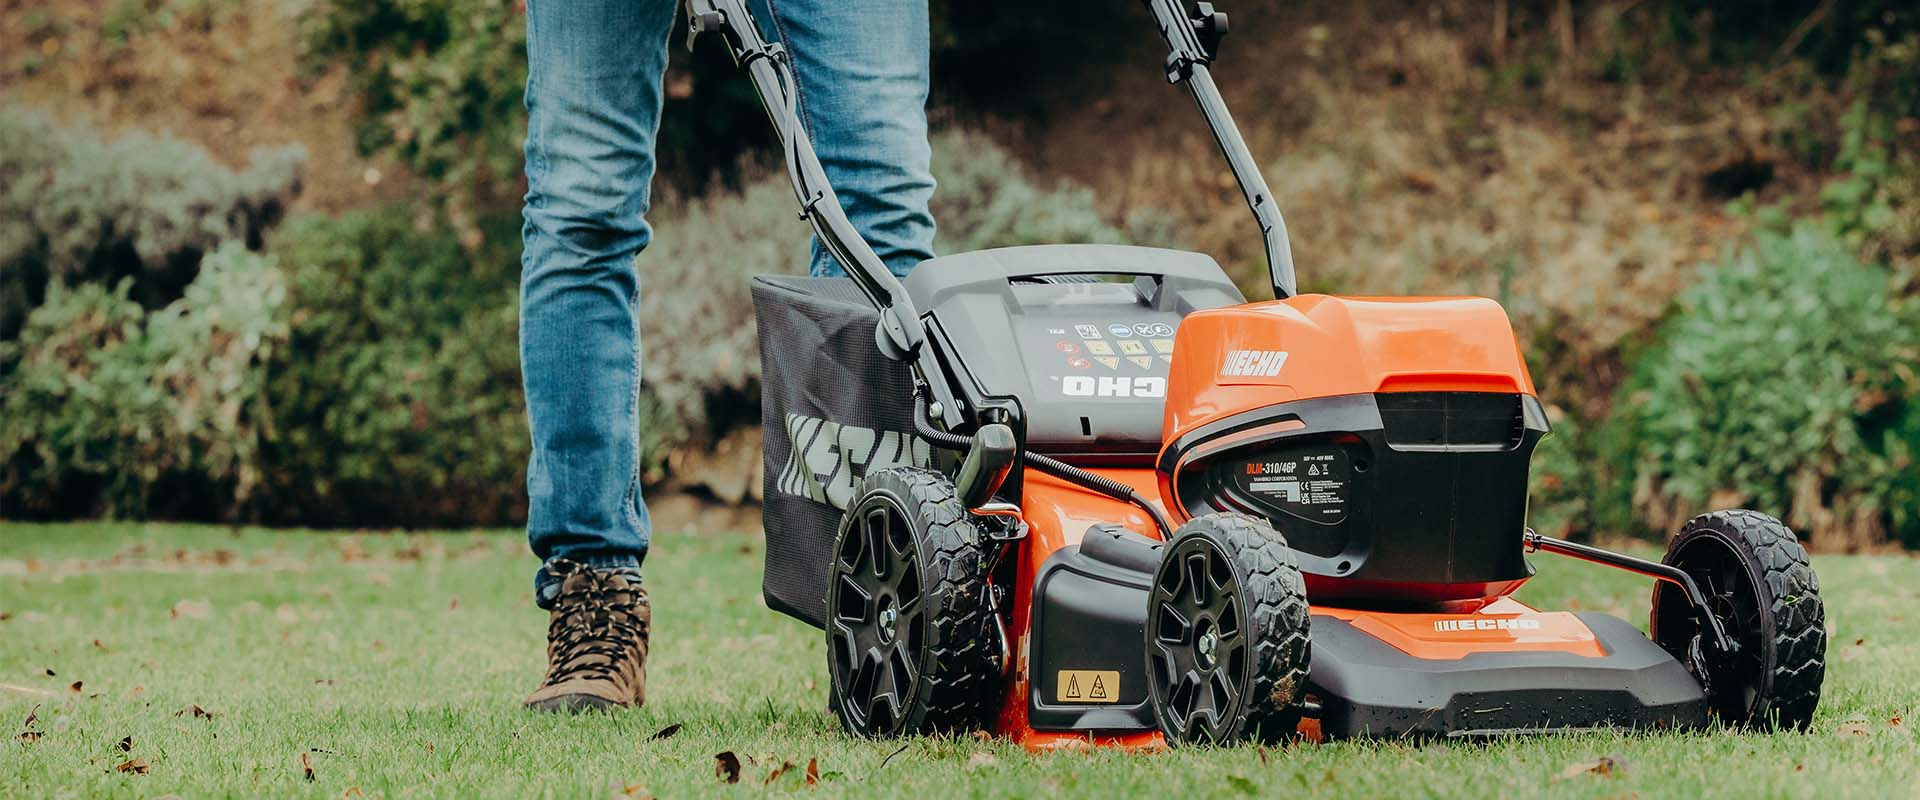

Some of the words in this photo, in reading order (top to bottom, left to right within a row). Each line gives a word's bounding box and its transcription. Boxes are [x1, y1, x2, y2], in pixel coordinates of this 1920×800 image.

[1230, 350, 1289, 377] ECHO
[1062, 376, 1166, 397] CHO
[803, 418, 931, 511] ECH
[1246, 462, 1297, 475] DLM-310/46P
[1457, 619, 1540, 632] ECHO
